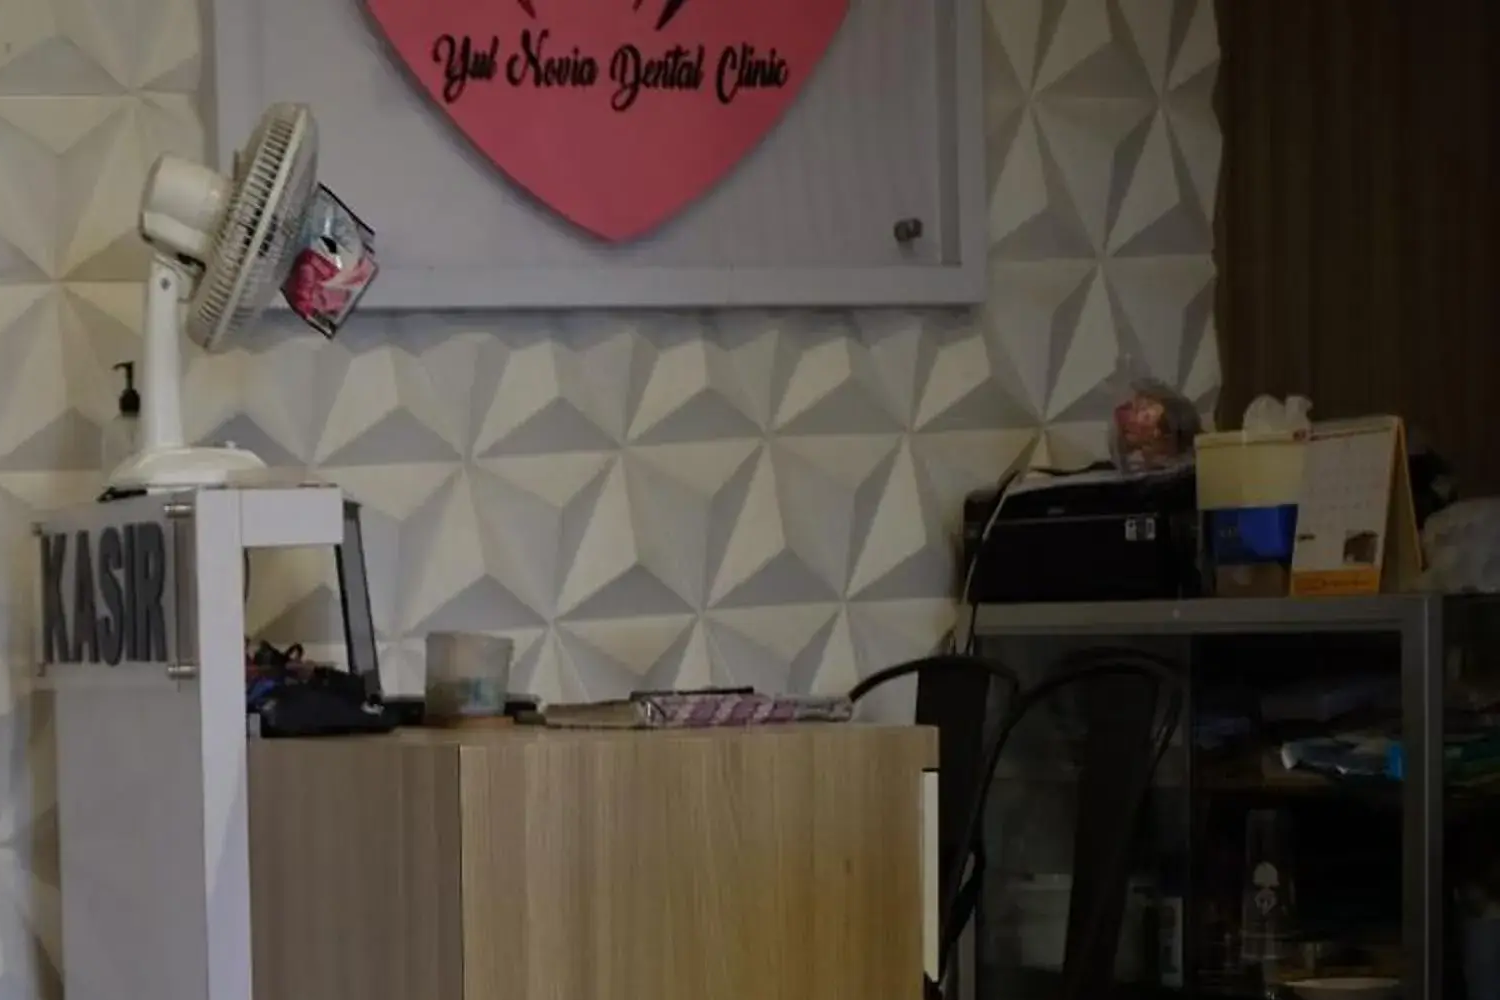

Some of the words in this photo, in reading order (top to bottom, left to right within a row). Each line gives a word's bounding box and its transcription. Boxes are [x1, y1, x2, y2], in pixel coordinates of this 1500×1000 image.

[431, 33, 499, 105] Yul
[505, 28, 599, 90] Novia
[610, 43, 705, 113] Dental
[715, 42, 790, 105] Clinic
[42, 521, 168, 667] KASIR
